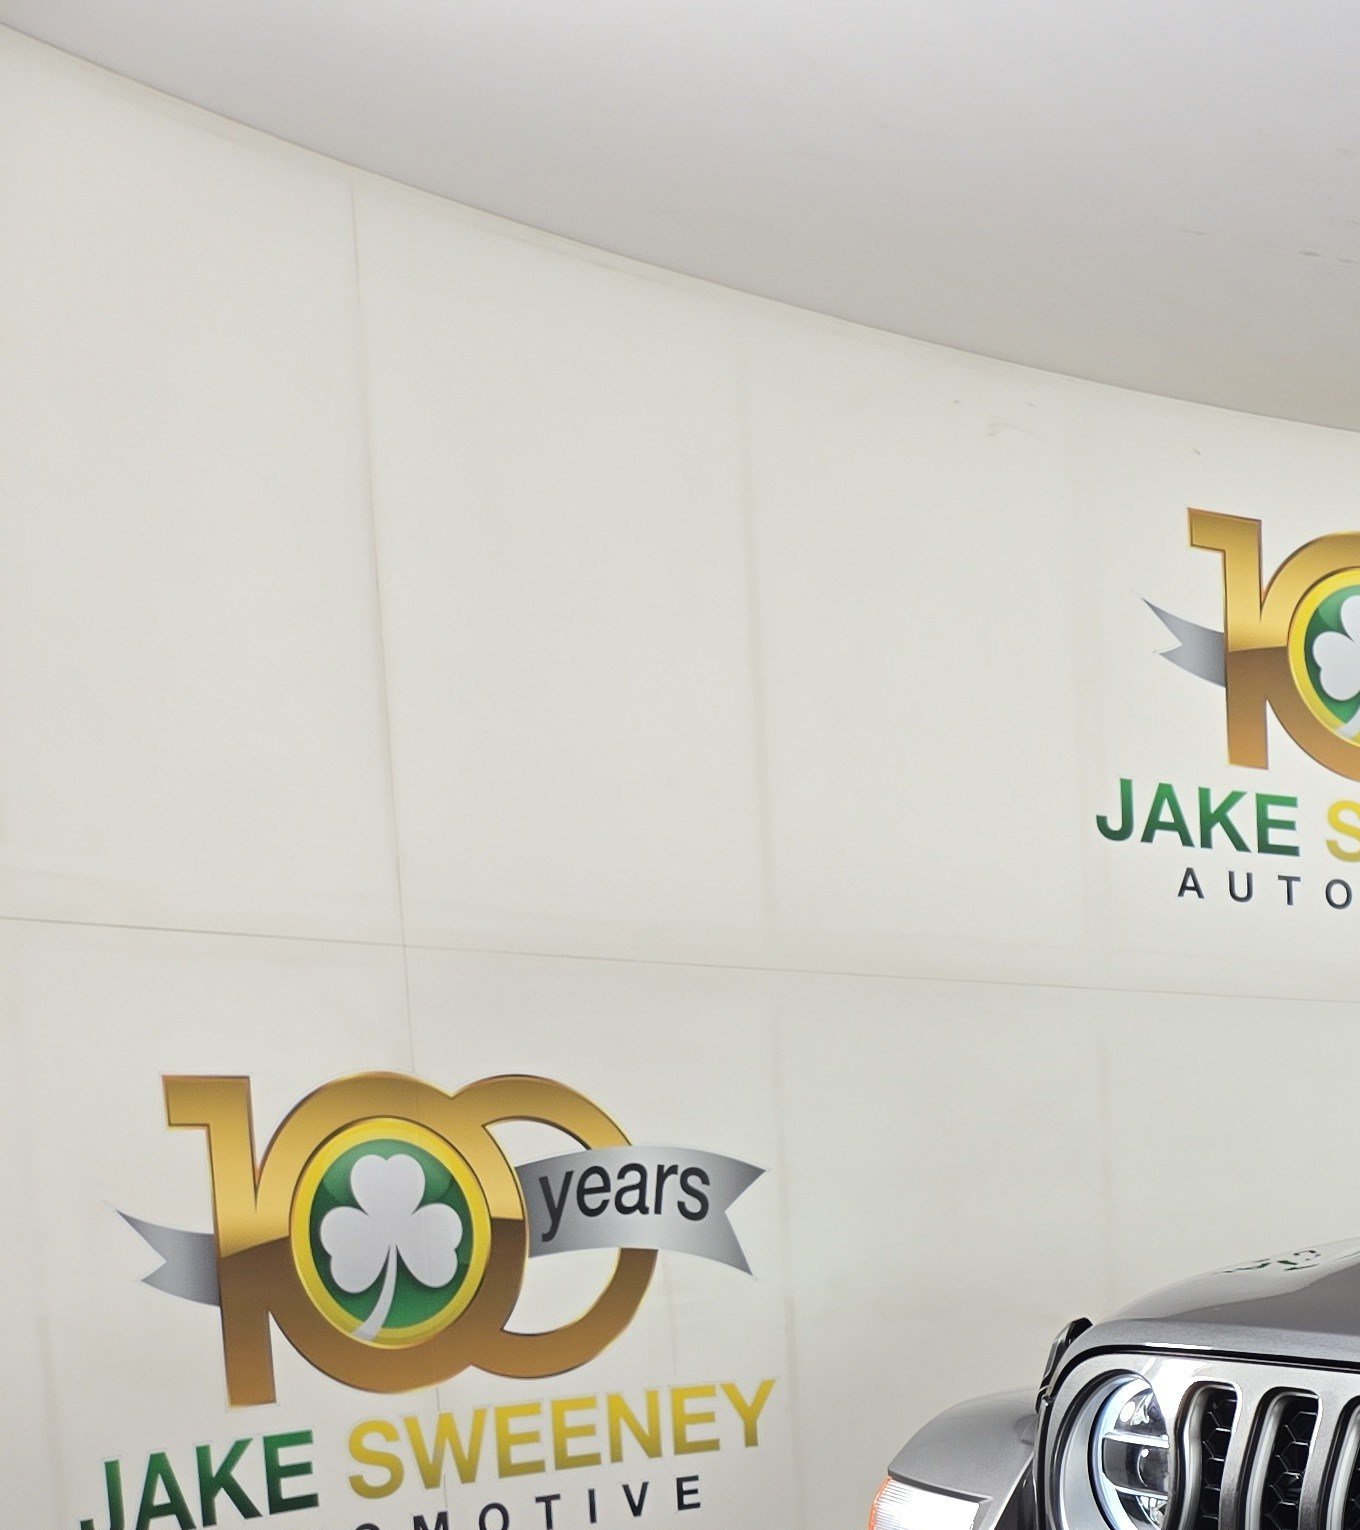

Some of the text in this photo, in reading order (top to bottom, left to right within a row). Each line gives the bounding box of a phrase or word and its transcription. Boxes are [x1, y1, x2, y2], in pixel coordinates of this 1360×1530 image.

[1096, 778, 1300, 857] JAKE
[538, 1162, 710, 1242] years
[347, 1379, 776, 1499] SWEENEY
